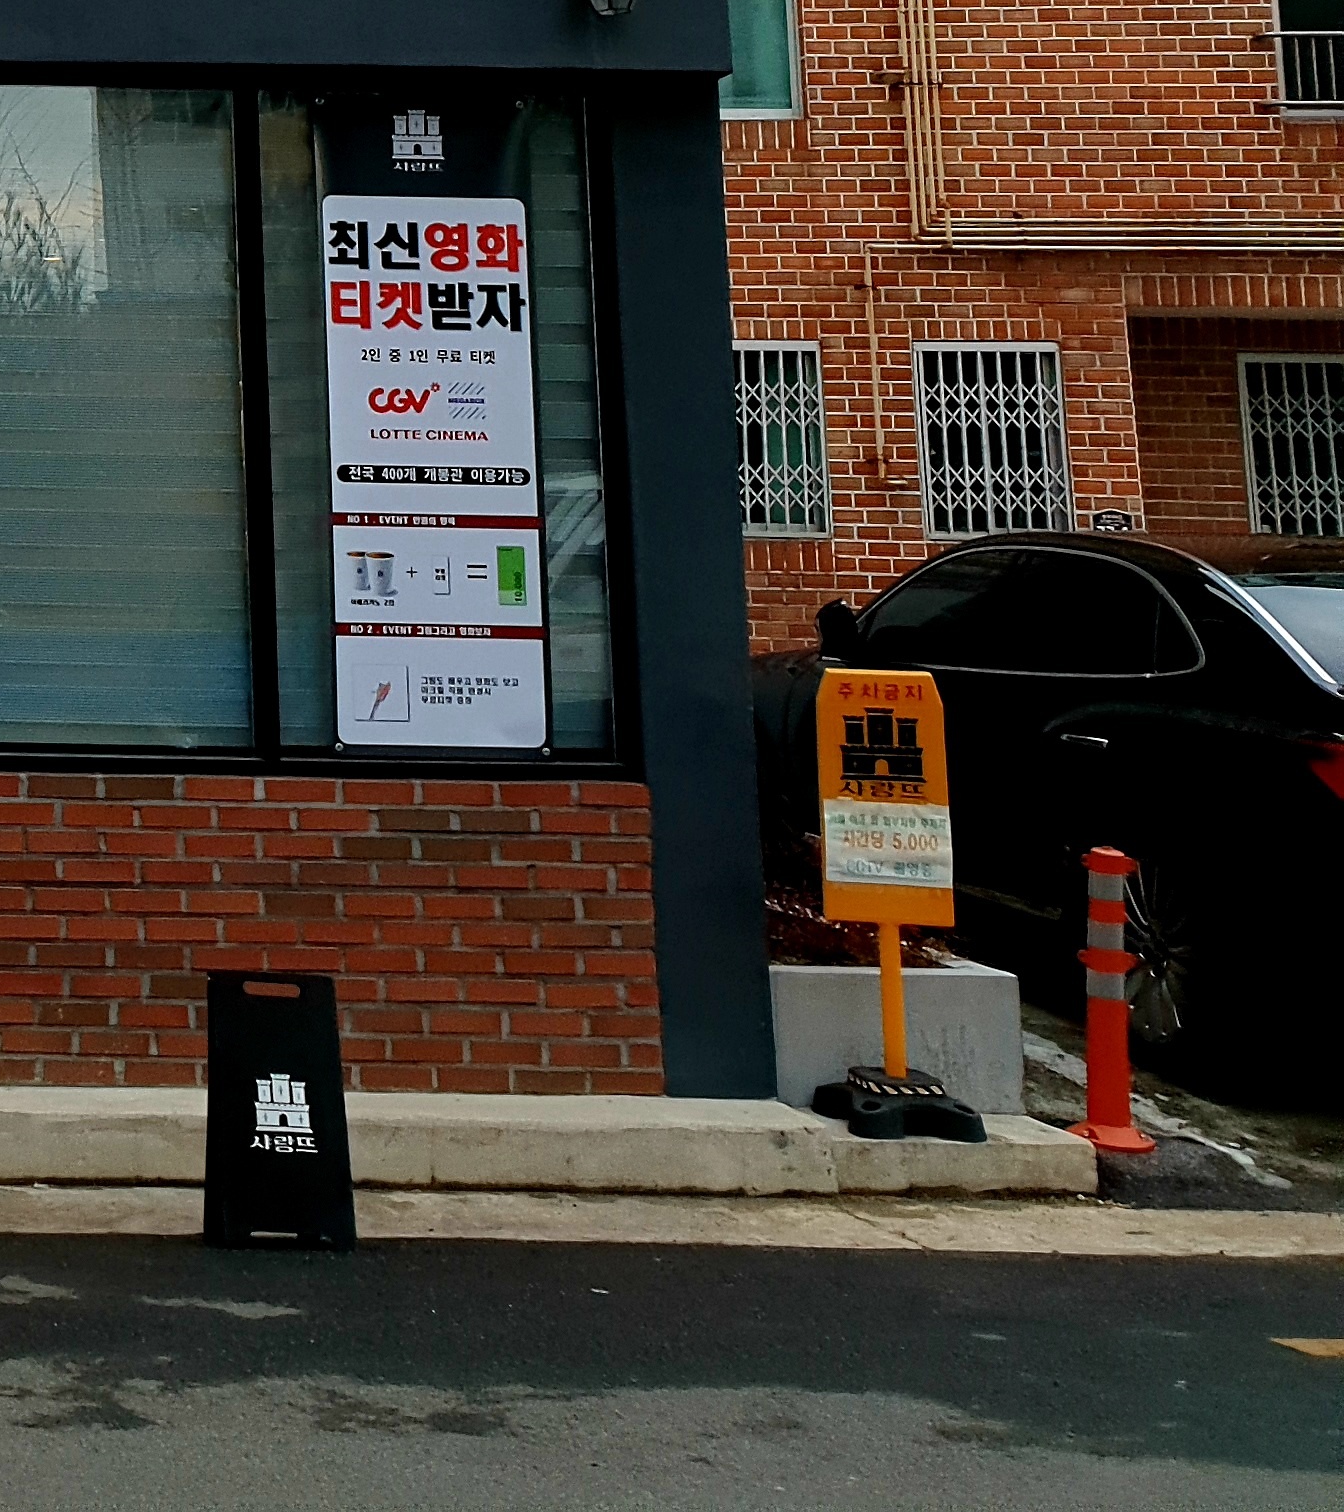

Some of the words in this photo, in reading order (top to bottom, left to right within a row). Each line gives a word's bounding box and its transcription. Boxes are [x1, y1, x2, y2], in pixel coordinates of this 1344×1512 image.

[361, 347, 381, 363] 2인
[389, 348, 401, 363] 중
[409, 349, 429, 363] 1인
[437, 350, 463, 363] 무료
[470, 350, 496, 364] 티켓
[368, 387, 431, 414] CGV
[370, 428, 422, 440] LOTTE
[425, 429, 489, 442] CINEMA
[348, 466, 374, 481] 전국
[382, 467, 416, 482] 400개
[470, 468, 525, 484] 이용가능
[379, 515, 409, 525] EVENT
[382, 625, 412, 635] EVENT
[837, 682, 923, 701] 주차금지
[840, 780, 927, 798] 사랑뜨
[892, 832, 939, 851] 5.000
[249, 1133, 319, 1154] 사랑뜨
